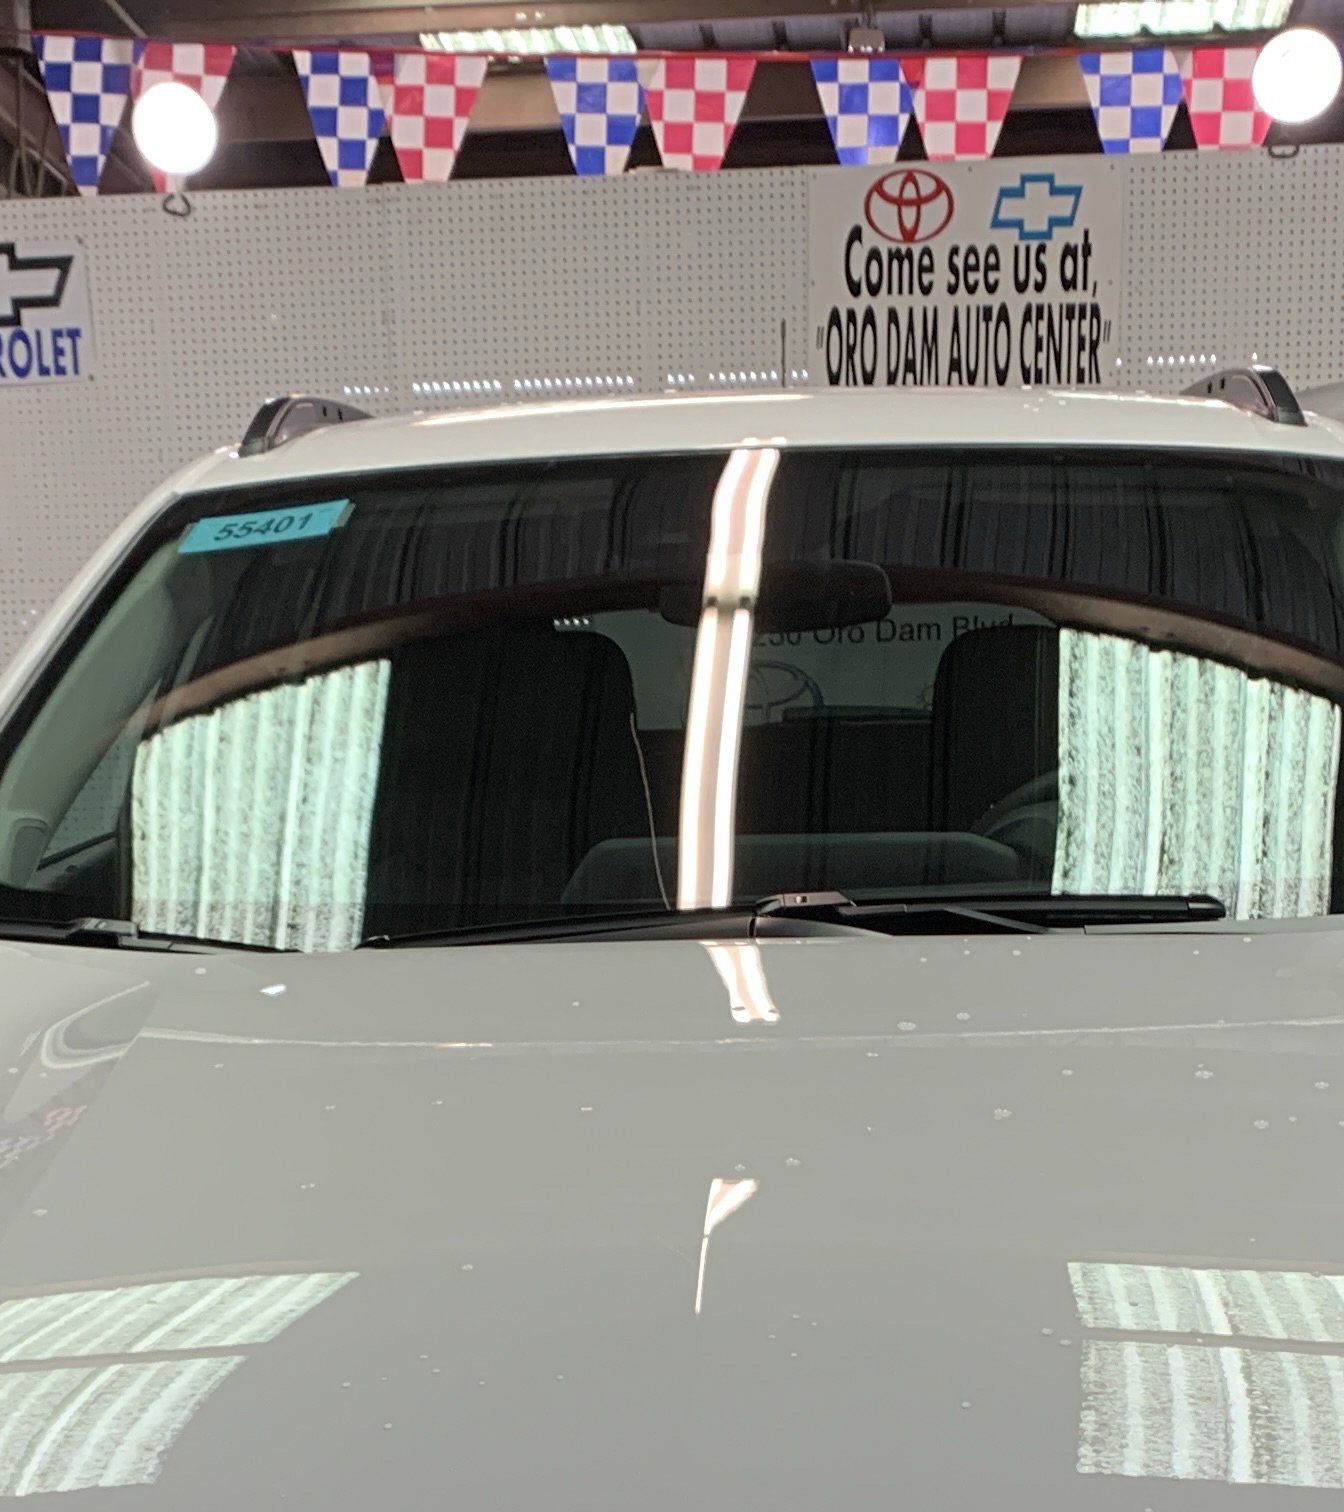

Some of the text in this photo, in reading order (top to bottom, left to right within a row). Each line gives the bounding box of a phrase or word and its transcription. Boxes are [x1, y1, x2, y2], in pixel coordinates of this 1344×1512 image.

[845, 224, 1098, 298] Come see us at,
[886, 305, 939, 387] DAM
[947, 302, 1012, 387] AUTO
[214, 511, 314, 542] 55401
[876, 619, 942, 643] Dam
